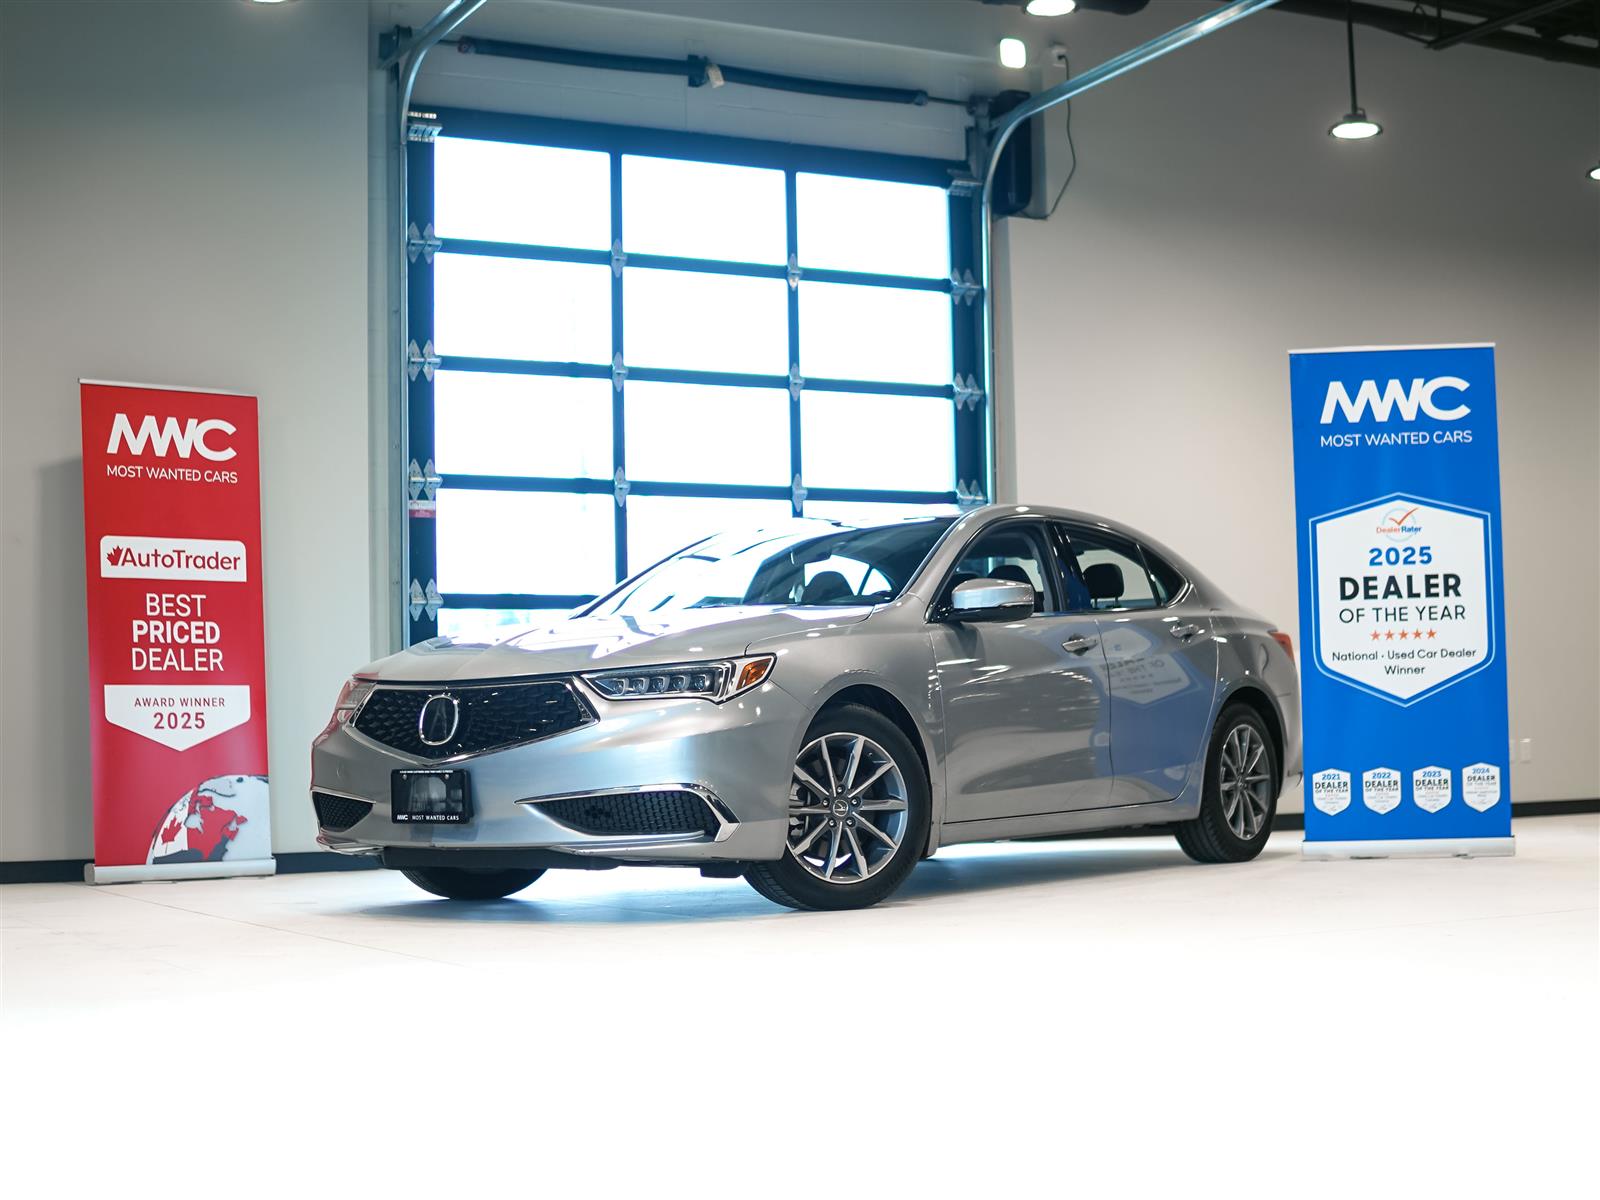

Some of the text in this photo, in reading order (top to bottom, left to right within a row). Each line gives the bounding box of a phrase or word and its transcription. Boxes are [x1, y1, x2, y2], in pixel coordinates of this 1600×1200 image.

[1320, 376, 1471, 424] MWC
[106, 413, 237, 462] MWC
[1320, 430, 1473, 447] MOST WANTED CARS
[106, 464, 238, 484] MOST WANTED CARS
[1376, 525, 1422, 534] DealerRater
[121, 547, 240, 570] AutoTrader
[1368, 546, 1433, 566] 2025
[1339, 573, 1462, 601] DEALER
[146, 593, 206, 617] BEST
[1339, 605, 1466, 624] OF THE YEAR
[132, 620, 220, 645] PRICED
[131, 647, 224, 672] DEALER
[1332, 648, 1477, 661] National Used Car Dealer
[1384, 665, 1425, 675] Winner
[134, 697, 226, 707] AWARD WINNER
[153, 712, 205, 730] 2025
[1314, 781, 1348, 789] DEALER
[1364, 780, 1398, 788] DEALER
[1415, 778, 1449, 787] DEALER
